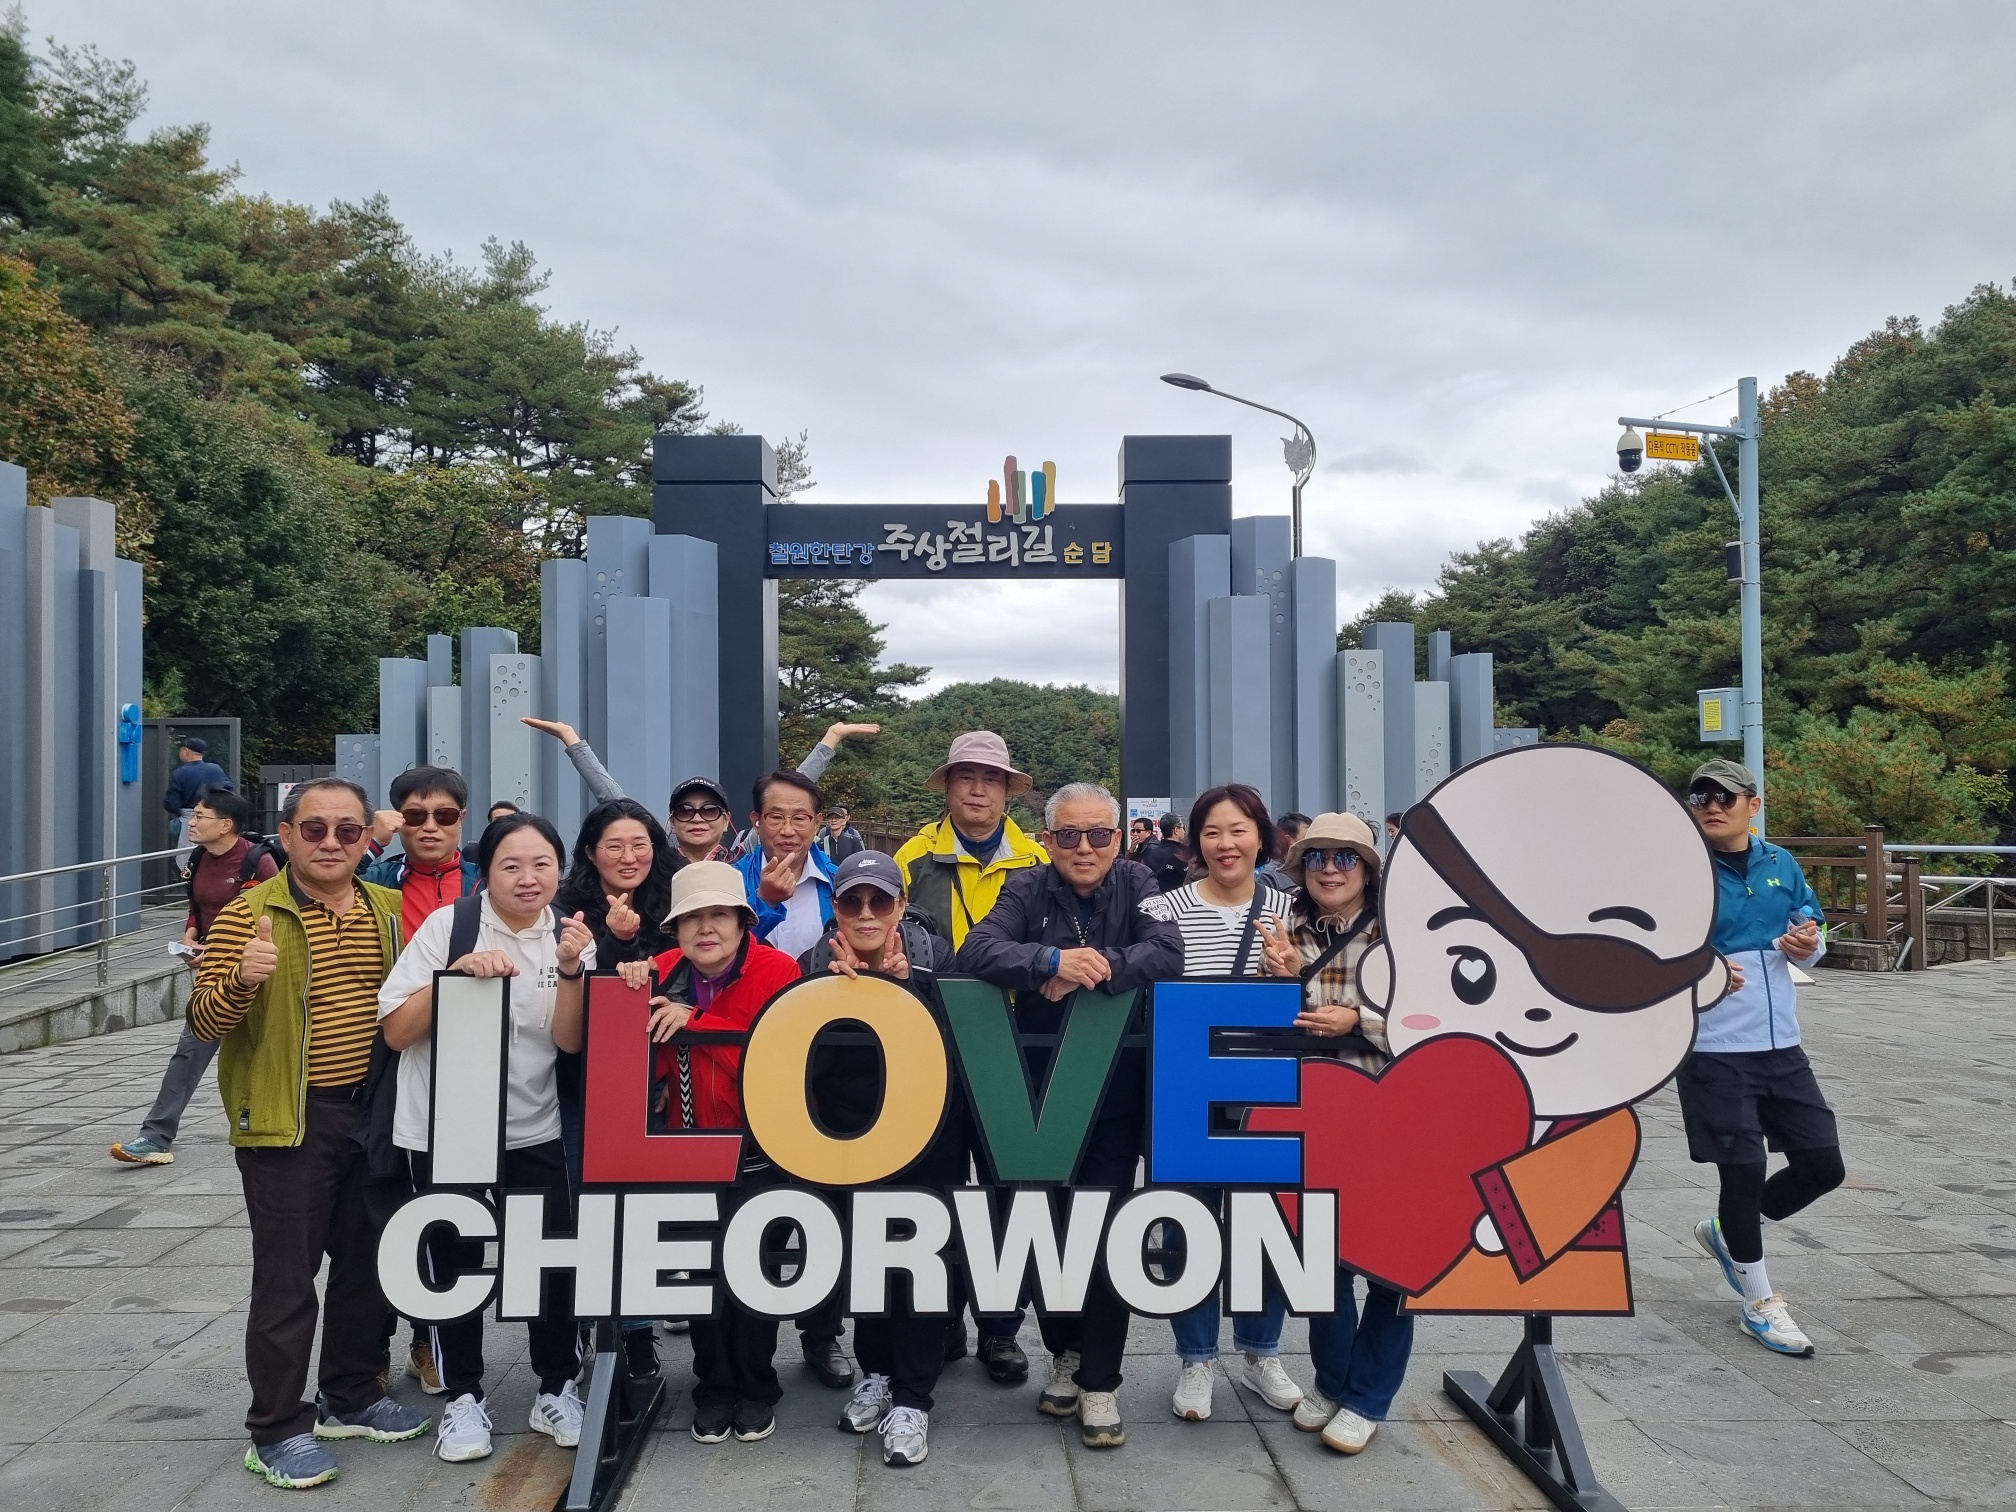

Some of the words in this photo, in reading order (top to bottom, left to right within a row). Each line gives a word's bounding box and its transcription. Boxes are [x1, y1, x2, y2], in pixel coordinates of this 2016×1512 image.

[1666, 442, 1679, 455] CCTV
[1680, 442, 1696, 457] 작동중
[769, 541, 875, 565] 철원한탄강
[877, 520, 1057, 571] 주상절리길
[431, 974, 502, 1184] I
[581, 973, 1301, 1186] LOVE
[376, 1188, 1336, 1321] CHEORWON
